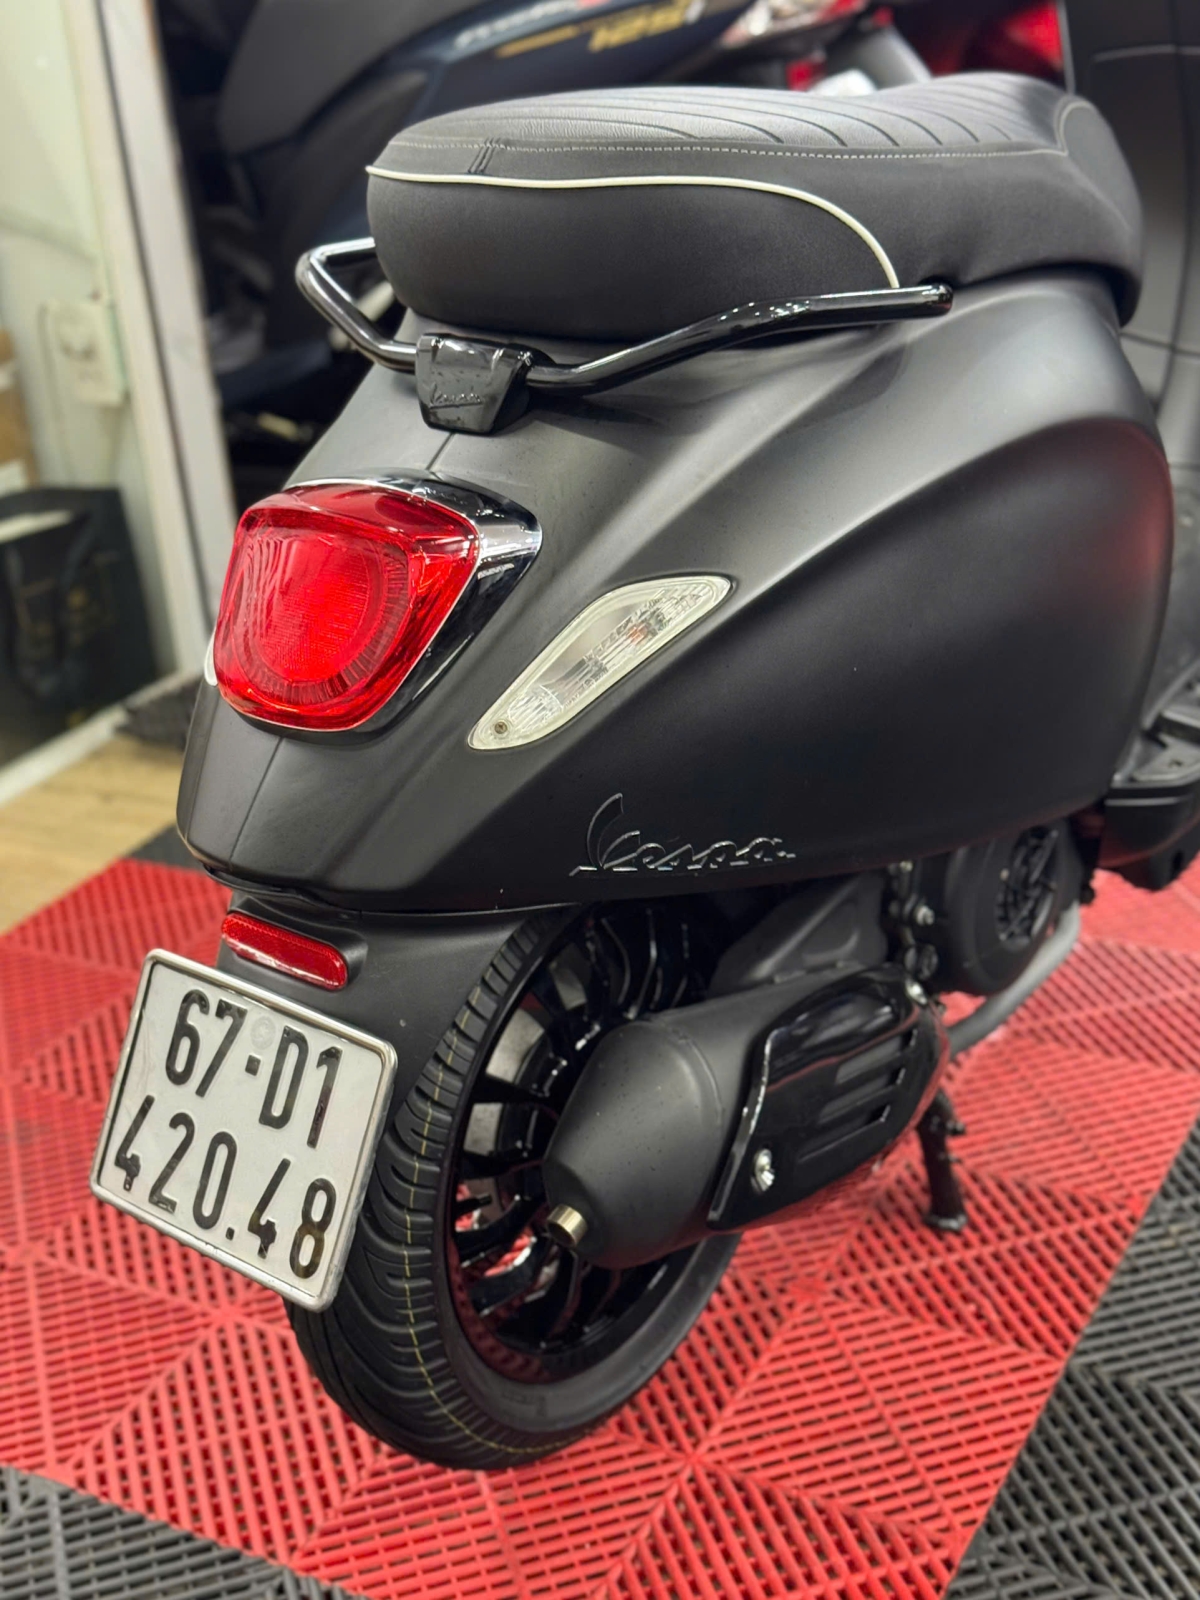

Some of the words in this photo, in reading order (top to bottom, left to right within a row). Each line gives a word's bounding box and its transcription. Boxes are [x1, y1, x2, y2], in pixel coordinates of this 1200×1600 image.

[569, 792, 797, 877] Vespa
[165, 989, 343, 1149] 67-D1
[114, 1094, 337, 1279] 420.48
